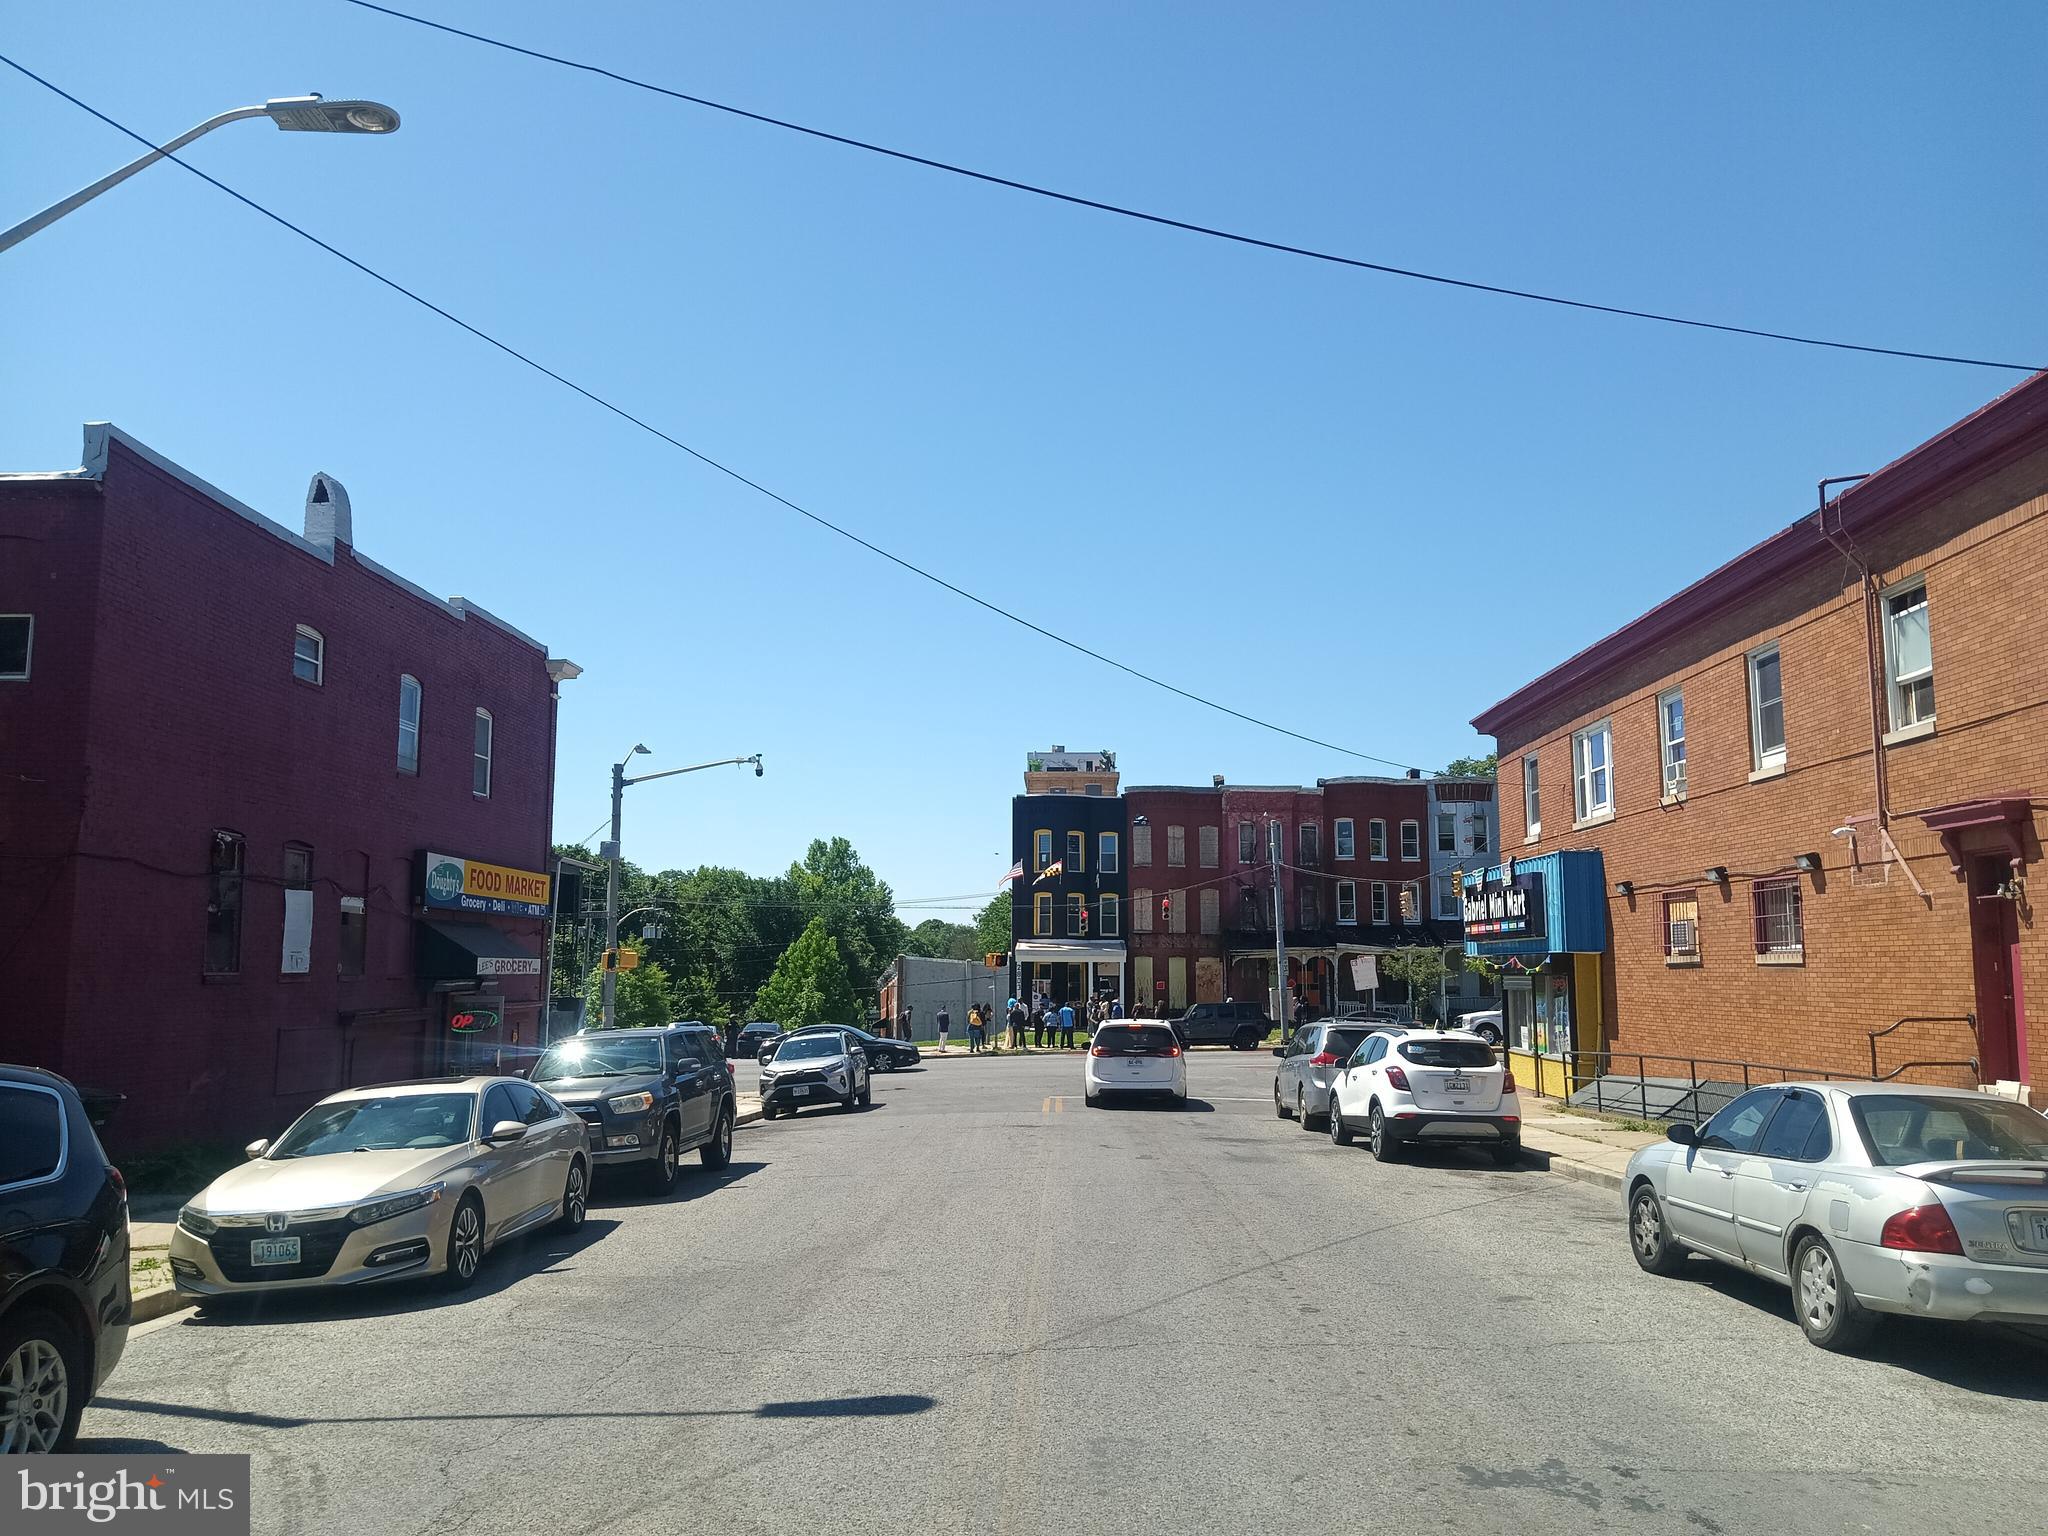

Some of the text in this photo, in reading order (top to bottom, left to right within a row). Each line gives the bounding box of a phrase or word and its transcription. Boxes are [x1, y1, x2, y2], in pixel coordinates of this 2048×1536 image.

[431, 871, 460, 897] Doughty's
[470, 868, 546, 898] FOOD MARKET
[461, 895, 487, 911] Grocery
[492, 899, 506, 911] Deli
[1463, 889, 1526, 921] Gabriel Mini Mart
[494, 960, 533, 973] GROCERY
